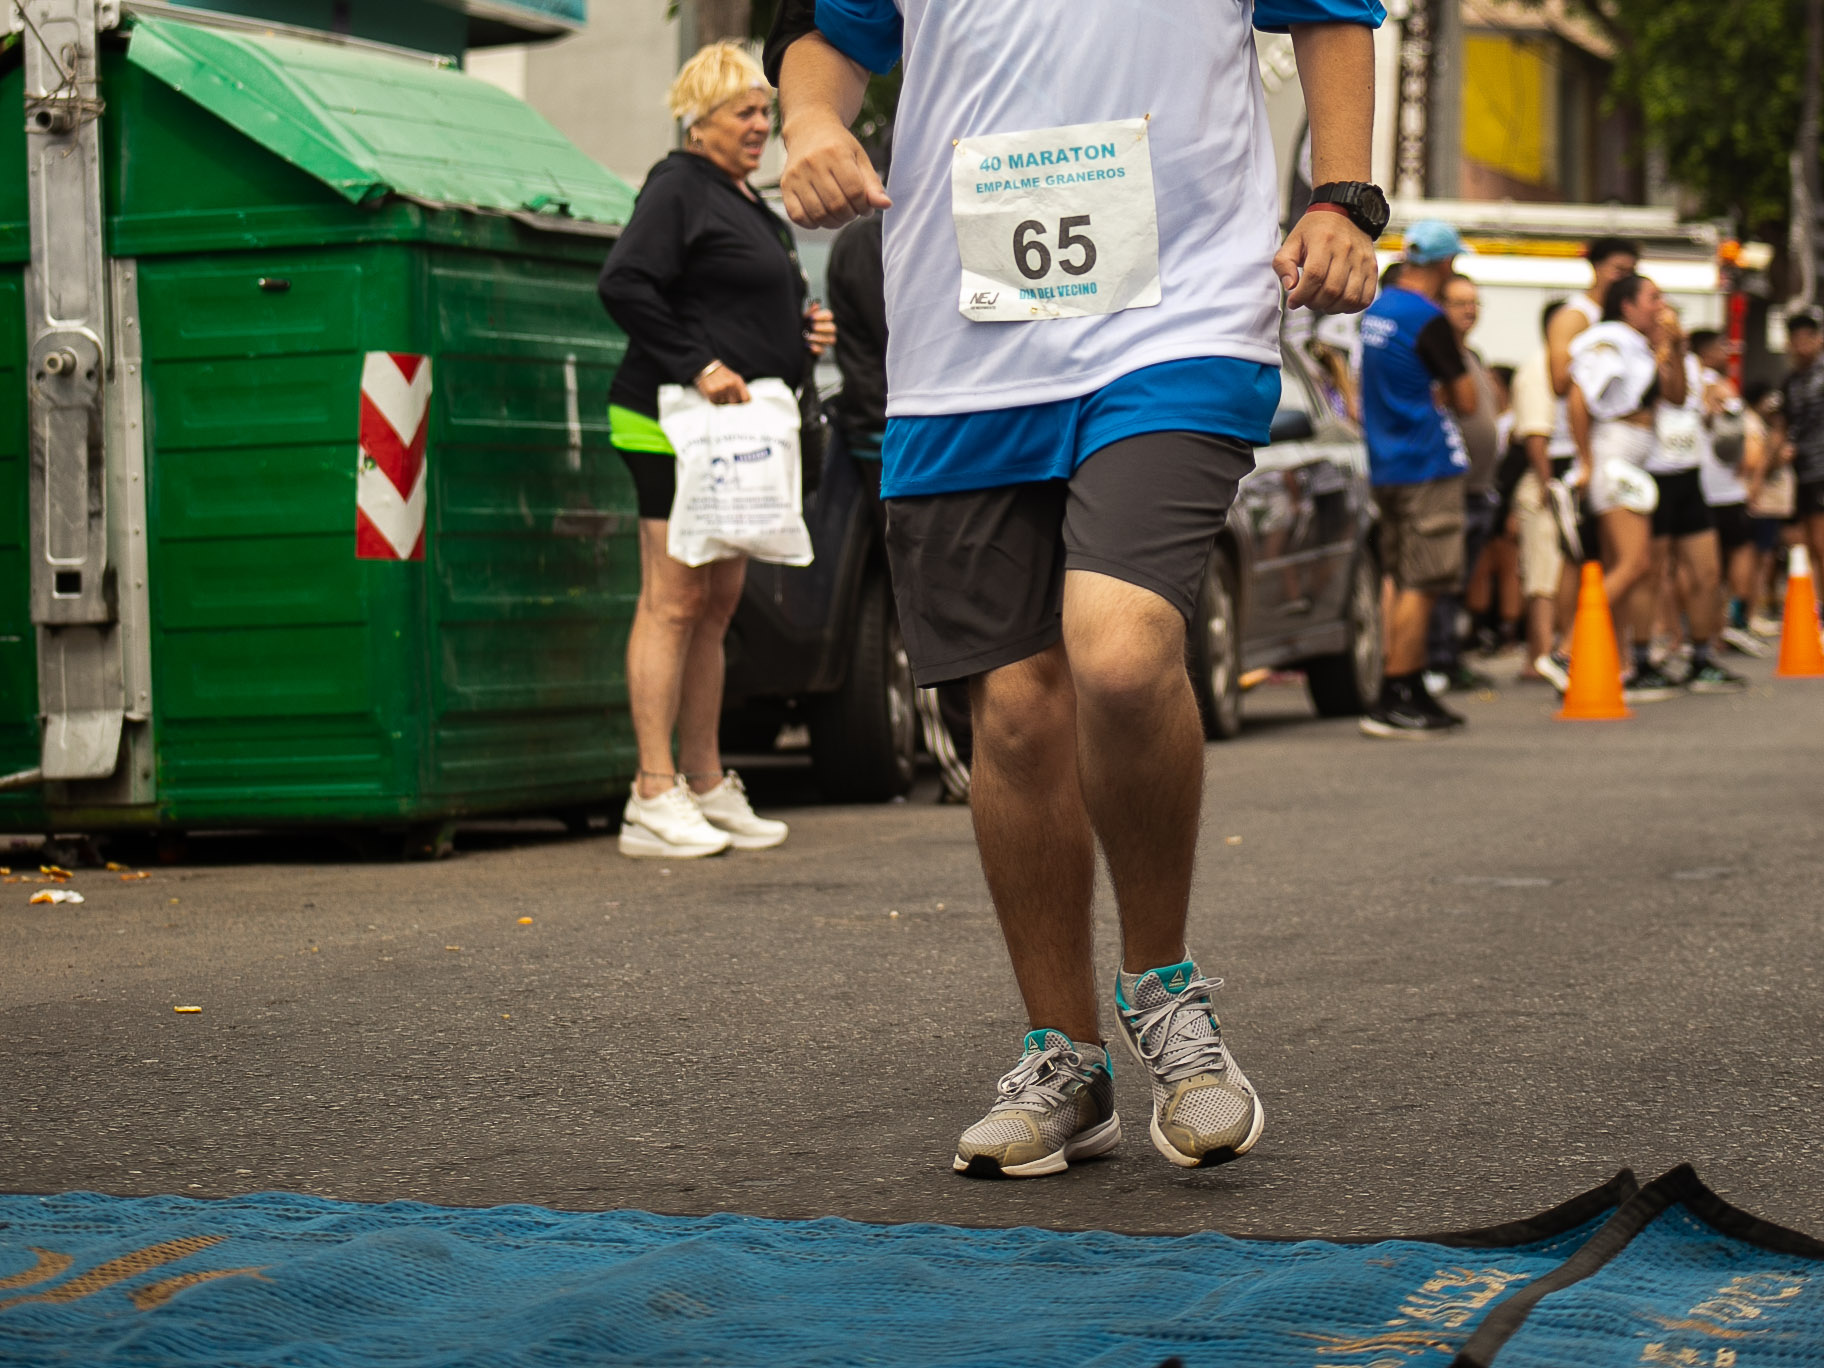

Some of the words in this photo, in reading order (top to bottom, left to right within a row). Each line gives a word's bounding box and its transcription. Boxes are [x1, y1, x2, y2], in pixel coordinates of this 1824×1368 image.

[979, 156, 1002, 172] 40
[1008, 142, 1116, 170] MARATON
[976, 177, 1040, 194] EMPALME
[1045, 167, 1126, 186] GRANEROS
[1012, 214, 1097, 280] 65
[969, 291, 1000, 305] NEJ
[1038, 287, 1056, 300] DEL
[1057, 282, 1098, 298] VECINO
